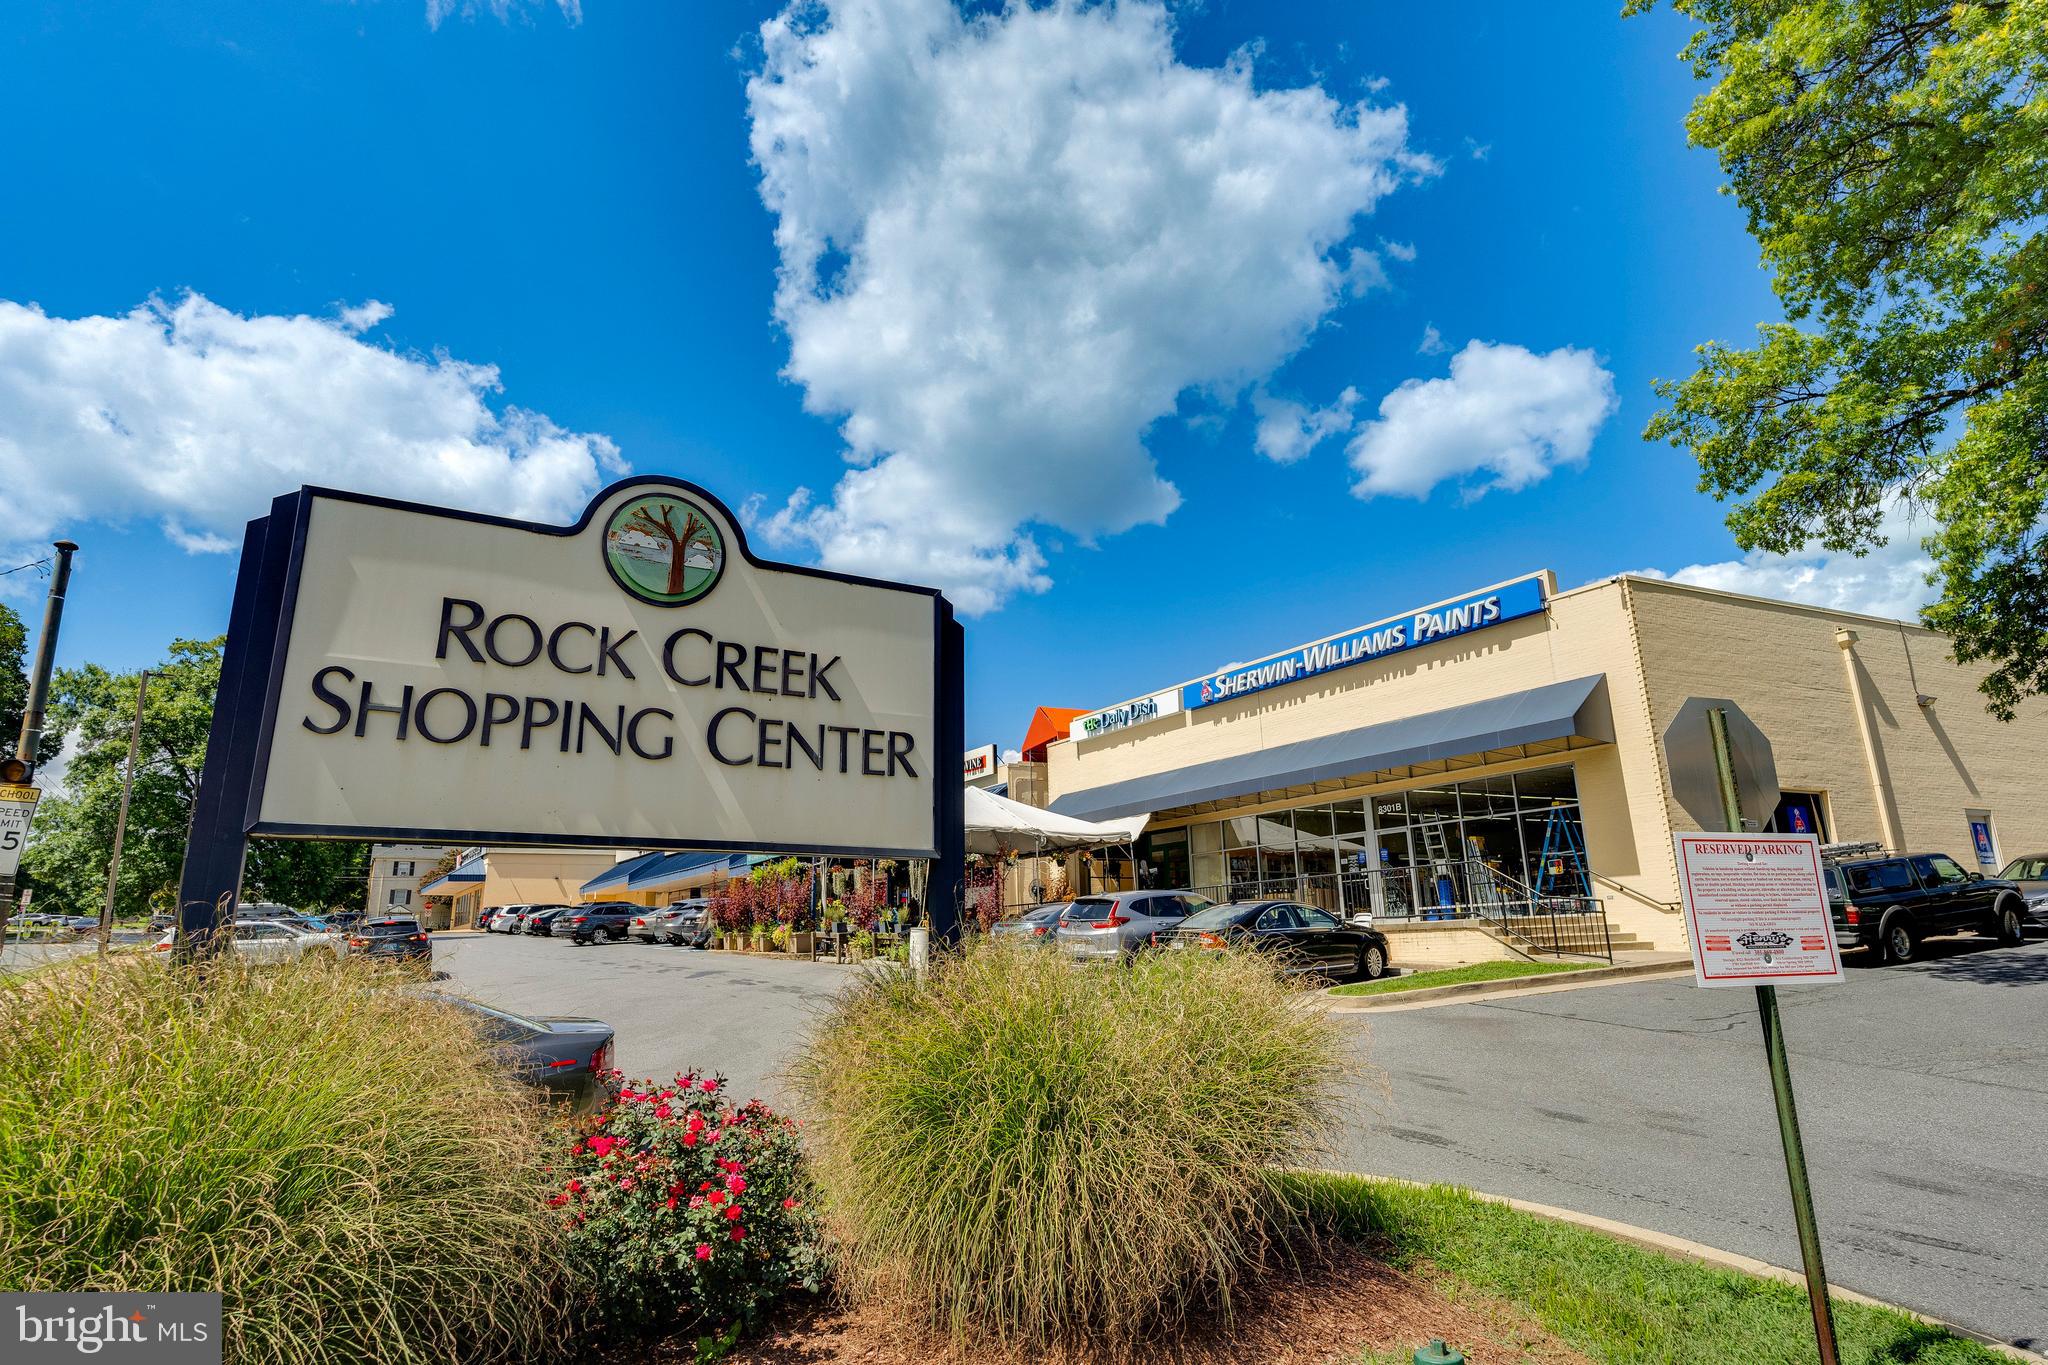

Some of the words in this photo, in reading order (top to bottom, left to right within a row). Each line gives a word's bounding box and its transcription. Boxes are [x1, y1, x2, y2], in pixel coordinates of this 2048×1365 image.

[435, 596, 638, 681] ROCK
[663, 628, 842, 702] CREEK
[1214, 624, 1406, 699] SHERWIN-WILLIAMS
[1413, 595, 1501, 641] PAINTS
[1100, 709, 1129, 728] Daily
[1130, 698, 1158, 720] Dish
[302, 665, 675, 760] SHOPPING
[707, 706, 920, 778] CENTER
[0, 789, 36, 800] CHOOL
[0, 807, 30, 818] PEED
[1377, 802, 1402, 814] 8301B
[0, 820, 22, 828] MIT
[0, 831, 20, 850] 5
[1695, 843, 1752, 855] RESERVED
[1754, 844, 1803, 855] PARKING
